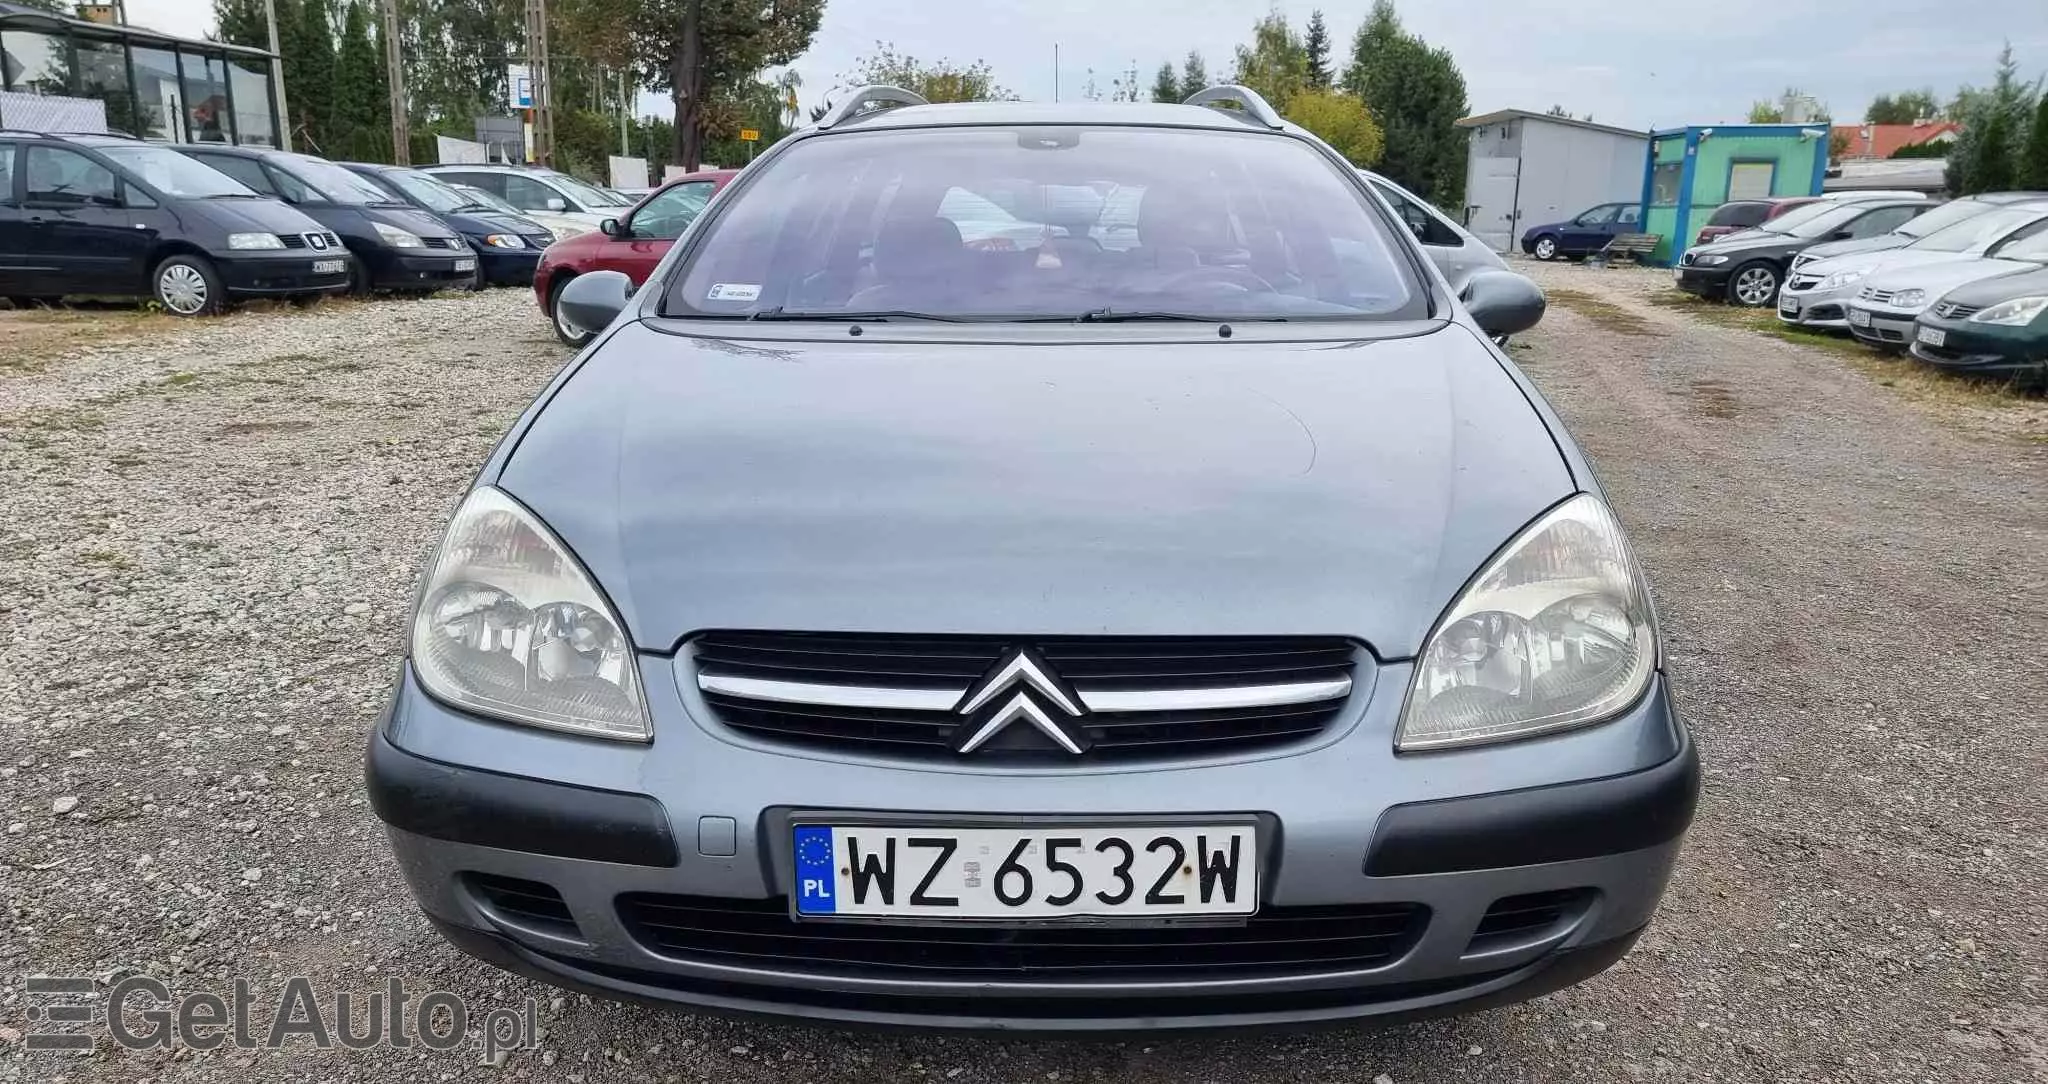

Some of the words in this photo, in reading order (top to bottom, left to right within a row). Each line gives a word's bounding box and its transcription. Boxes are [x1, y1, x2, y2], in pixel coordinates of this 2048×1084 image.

[803, 879, 831, 898] PL
[846, 836, 960, 907] WZ
[993, 834, 1241, 907] 6532W
